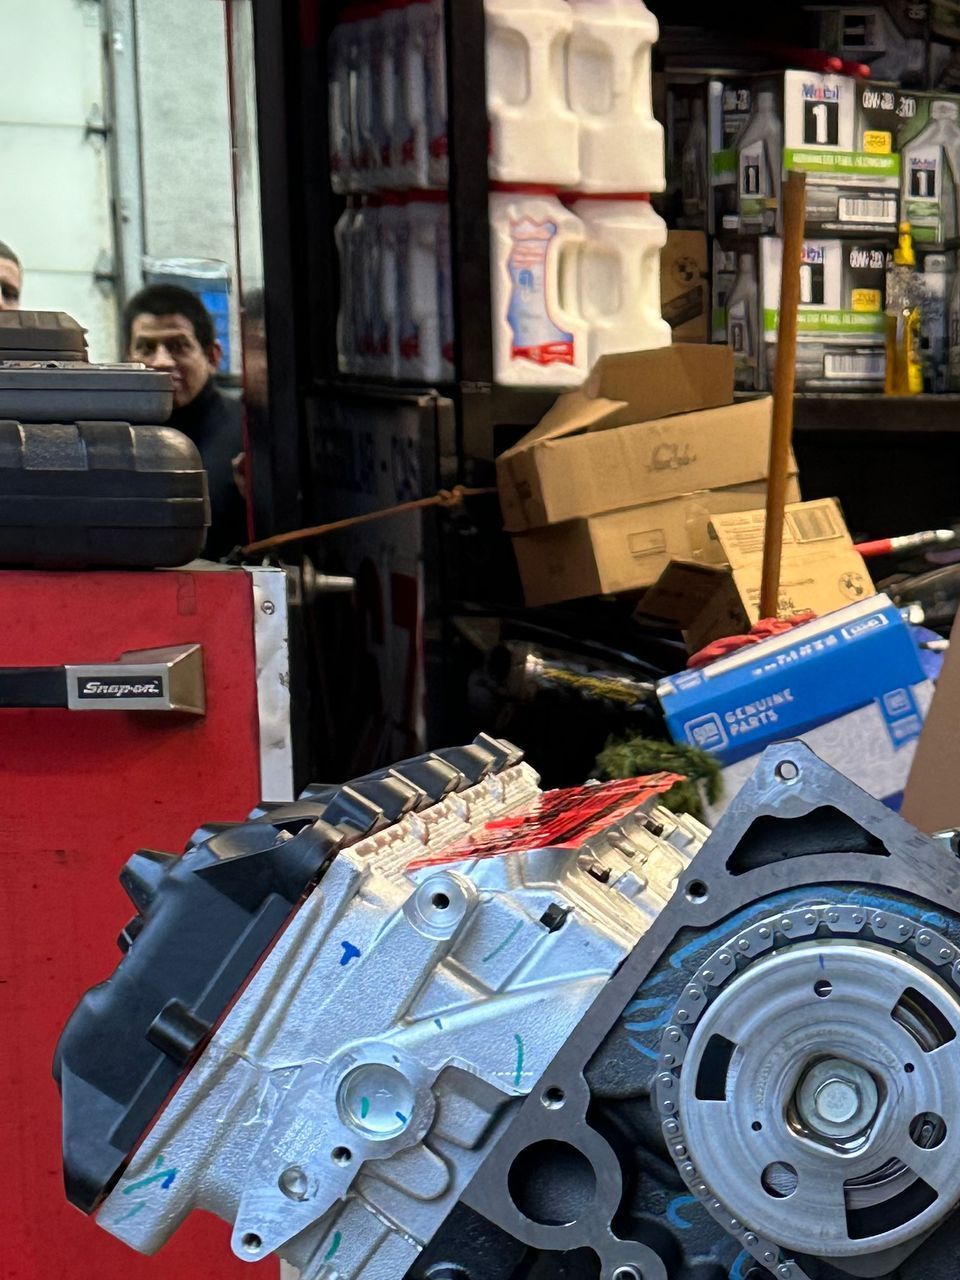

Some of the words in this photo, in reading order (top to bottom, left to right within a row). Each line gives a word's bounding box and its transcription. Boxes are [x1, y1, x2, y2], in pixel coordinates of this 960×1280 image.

[83, 681, 159, 696] Snap-on
[725, 688, 794, 723] GENUINE
[729, 710, 778, 736] PARTS
